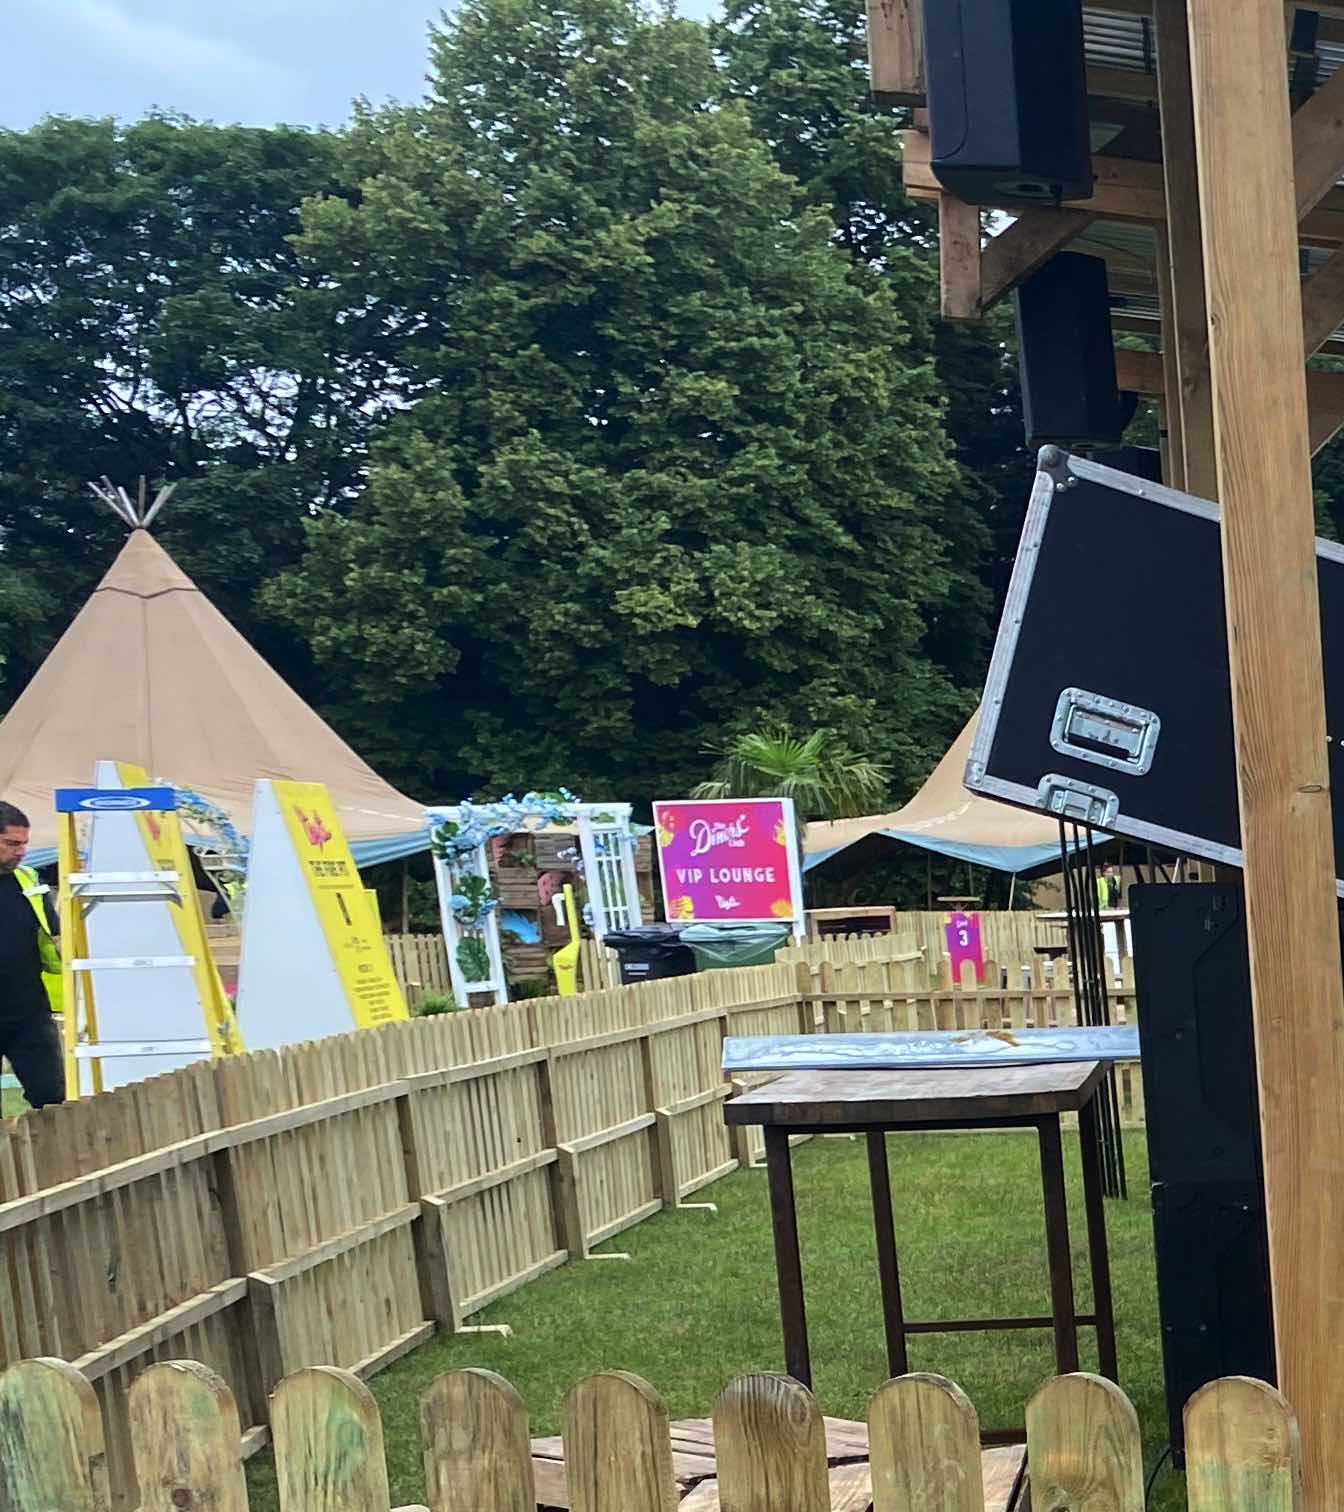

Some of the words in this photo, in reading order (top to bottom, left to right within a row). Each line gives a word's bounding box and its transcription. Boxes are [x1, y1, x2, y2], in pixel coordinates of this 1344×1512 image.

[676, 868, 703, 884] VIP
[709, 867, 776, 884] LOUNGE
[958, 929, 969, 947] 3
